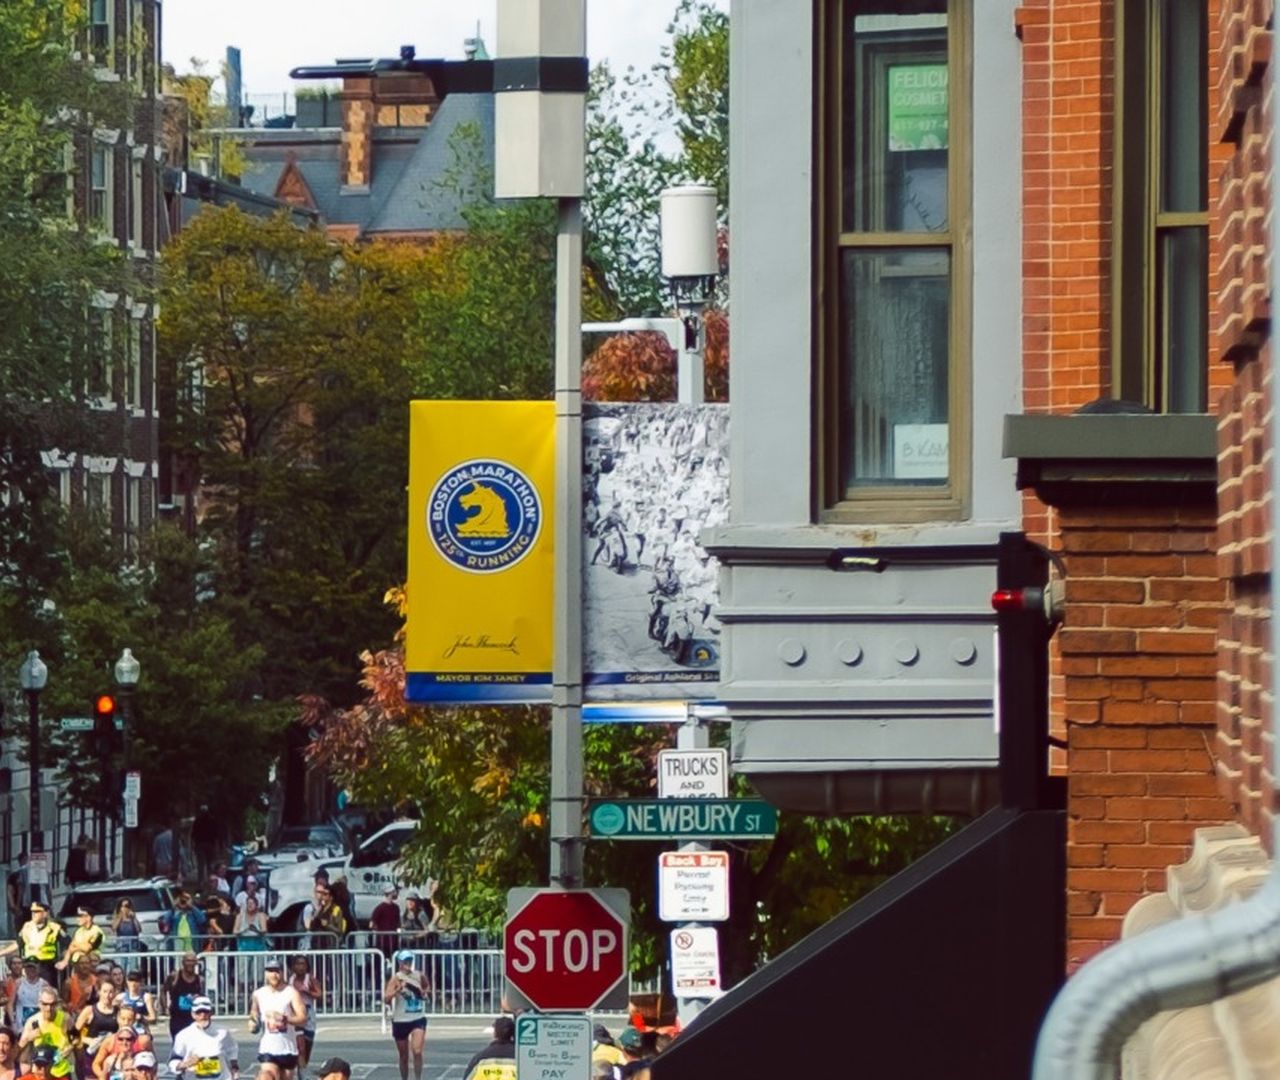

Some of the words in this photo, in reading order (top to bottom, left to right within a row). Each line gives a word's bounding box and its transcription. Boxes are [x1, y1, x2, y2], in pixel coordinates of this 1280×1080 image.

[432, 470, 467, 520] BOSTON
[471, 465, 535, 519] MARATHON
[467, 535, 529, 567] RUNNING
[435, 674, 472, 683] MAYOR
[473, 674, 493, 683] KIM
[494, 674, 526, 683] JANEY
[665, 758, 719, 777] TRUCKS
[680, 782, 705, 791] AND
[627, 804, 741, 832] NEWBURY
[745, 814, 762, 831] ST
[512, 928, 617, 974] STOP
[521, 1021, 536, 1037] 2
[541, 1069, 567, 1078] PAY
